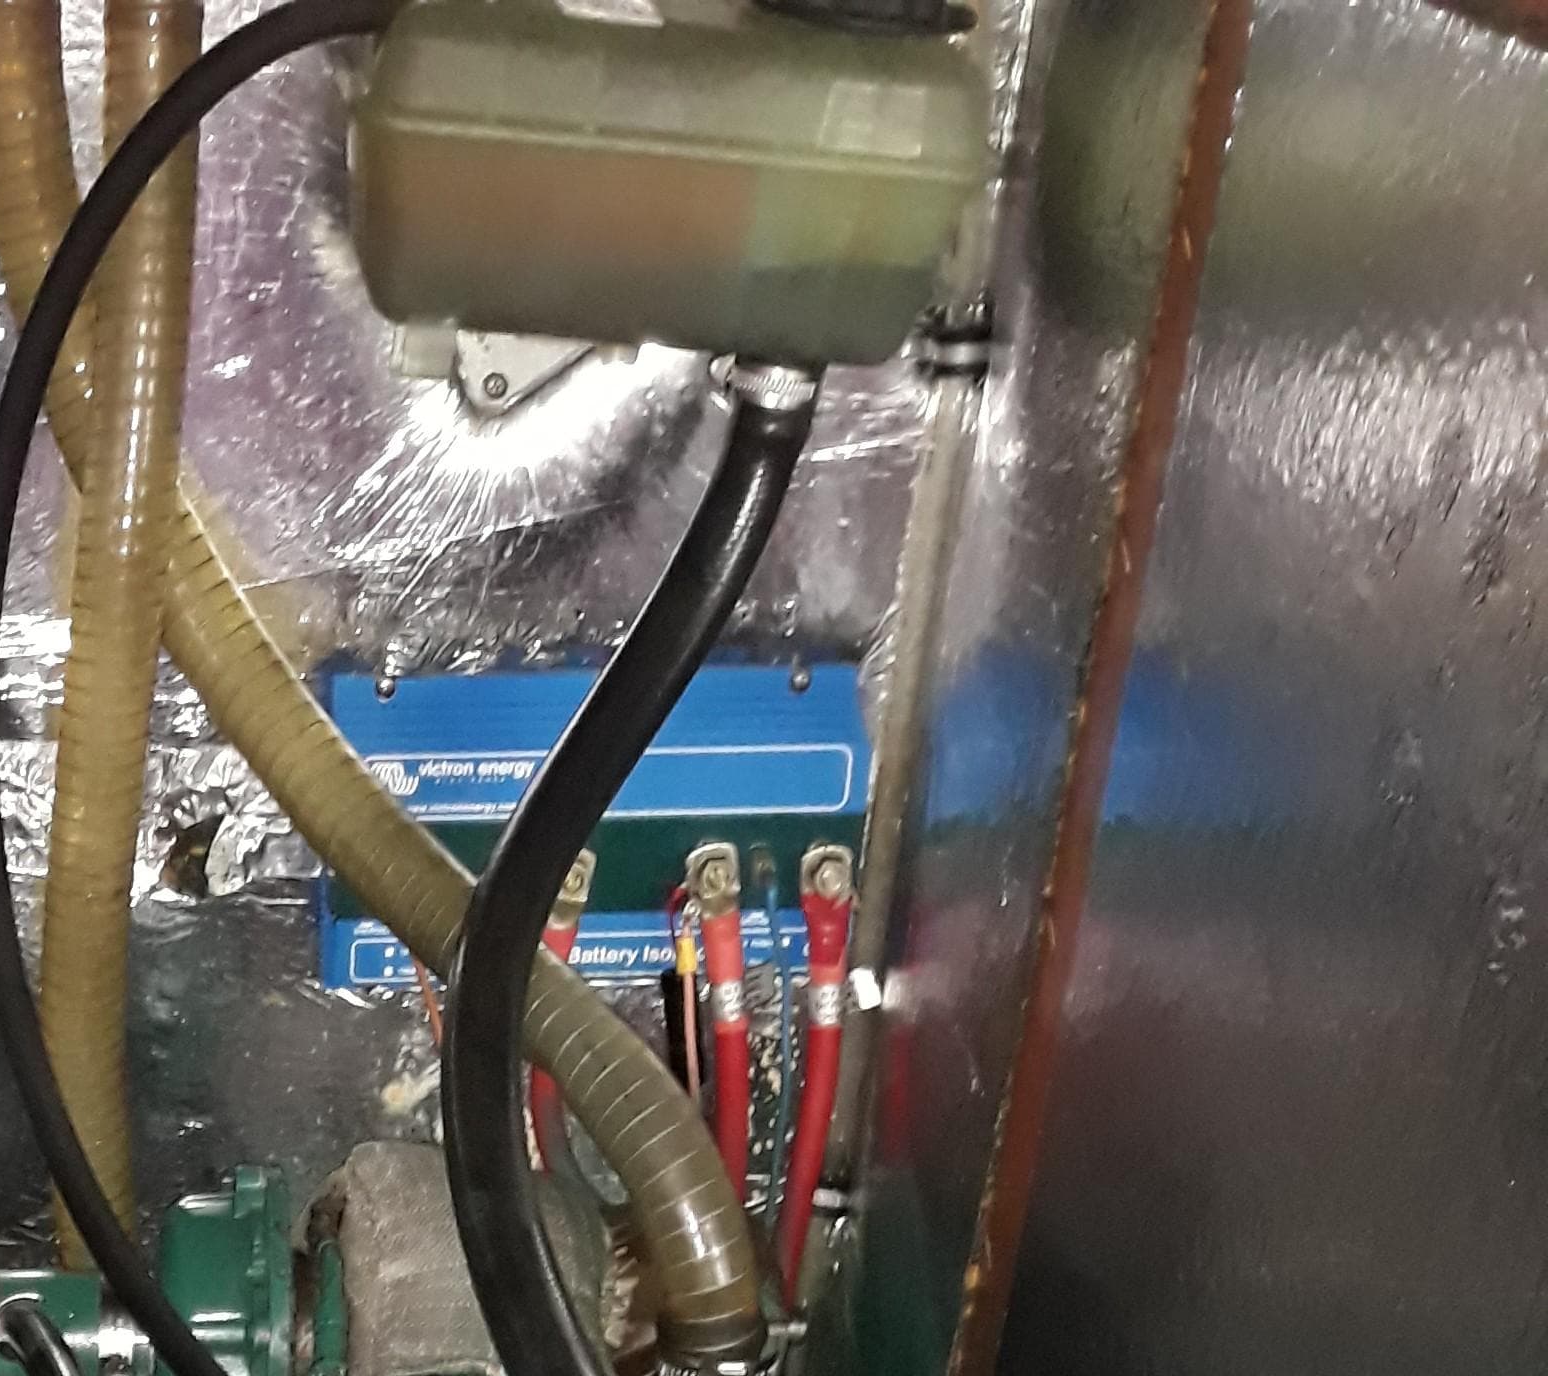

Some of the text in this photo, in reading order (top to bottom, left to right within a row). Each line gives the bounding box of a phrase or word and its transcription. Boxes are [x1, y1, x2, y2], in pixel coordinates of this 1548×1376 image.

[418, 759, 535, 779] victron energy
[567, 945, 639, 968] Battery
